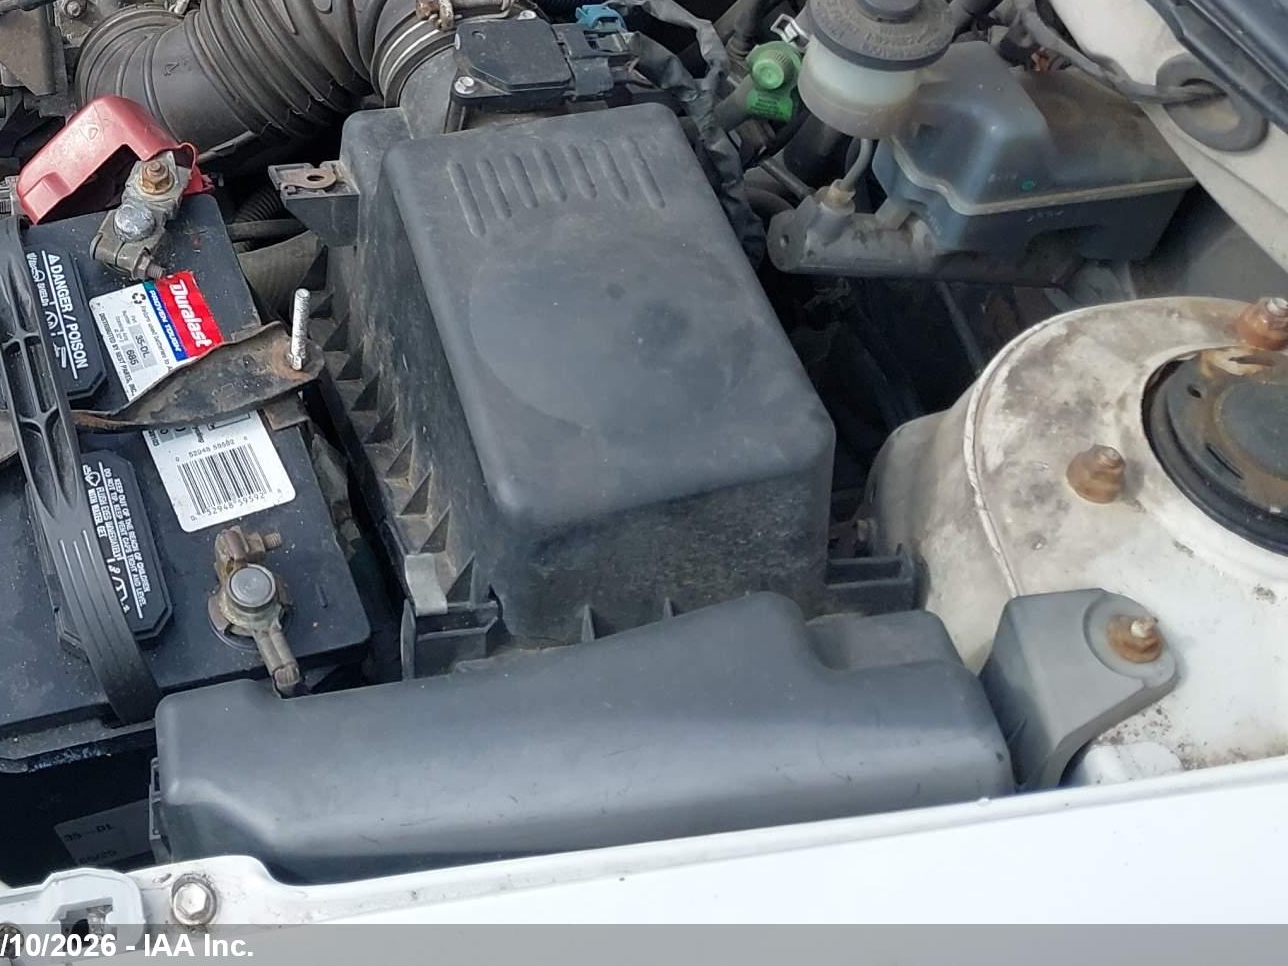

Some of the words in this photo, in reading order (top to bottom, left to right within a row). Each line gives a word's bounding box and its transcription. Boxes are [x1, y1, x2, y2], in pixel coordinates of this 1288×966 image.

[50, 264, 73, 312] DANGER
[66, 322, 88, 369] POISON
[148, 289, 168, 323] PROVEN
[164, 321, 182, 352] TOUGH
[169, 279, 212, 348] Duralast
[99, 313, 116, 344] DISTRIBUTED
[112, 343, 119, 351] BY
[135, 334, 150, 358] 35-DL
[154, 335, 167, 358] batteries
[127, 349, 139, 365] 685
[103, 468, 111, 477] DO
[107, 477, 115, 491] NOT
[114, 478, 123, 493] KEEP
[96, 486, 107, 506] FLUSH
[118, 494, 127, 507] OUT
[206, 504, 234, 516] 52948
[237, 494, 265, 507] 59592
[88, 488, 98, 504] WITH
[96, 525, 107, 538] GET
[101, 505, 112, 520] EYES
[114, 504, 123, 519] KEEP
[122, 508, 130, 517] OF
[118, 520, 128, 535] VENT
[124, 517, 134, 531] THE
[105, 521, 121, 558] IMMEDIATELY
[122, 537, 132, 553] CAPS
[128, 531, 139, 552] REACH
[128, 554, 138, 572] TIGHT
[134, 552, 142, 561] OF
[133, 573, 141, 586] AND
[137, 562, 150, 592] CHILDREN
[136, 587, 147, 607] LEVEL
